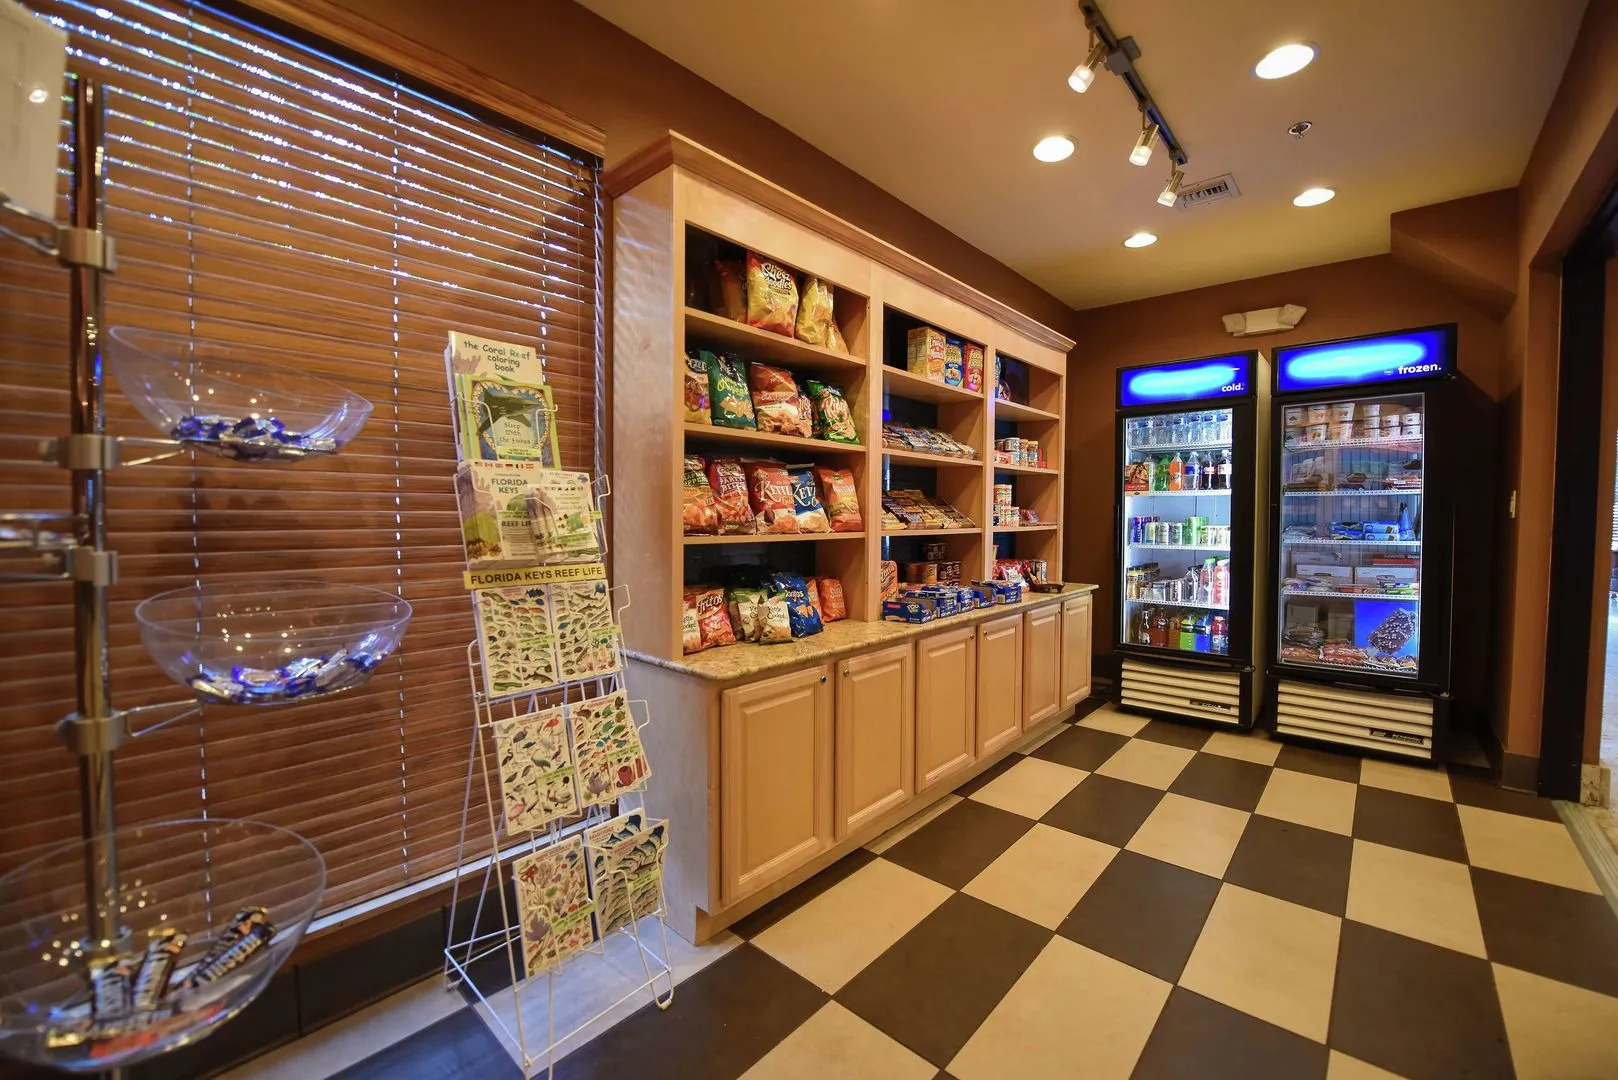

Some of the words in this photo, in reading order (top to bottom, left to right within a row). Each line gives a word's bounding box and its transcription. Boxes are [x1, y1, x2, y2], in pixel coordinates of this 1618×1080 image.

[464, 341, 479, 350] the
[482, 344, 506, 355] Coral
[509, 349, 531, 360] Reef
[487, 354, 520, 367] coloring
[494, 363, 515, 372] book
[1397, 363, 1442, 375] frozen.
[1221, 383, 1244, 393] cold.
[491, 478, 528, 486] FLORIDA
[499, 486, 519, 494] KEYS
[471, 572, 521, 585] FLORIDA
[524, 571, 552, 583] KEYS
[555, 568, 580, 578] REEF
[582, 567, 602, 576] LIFE
[697, 594, 723, 614] Fritos
